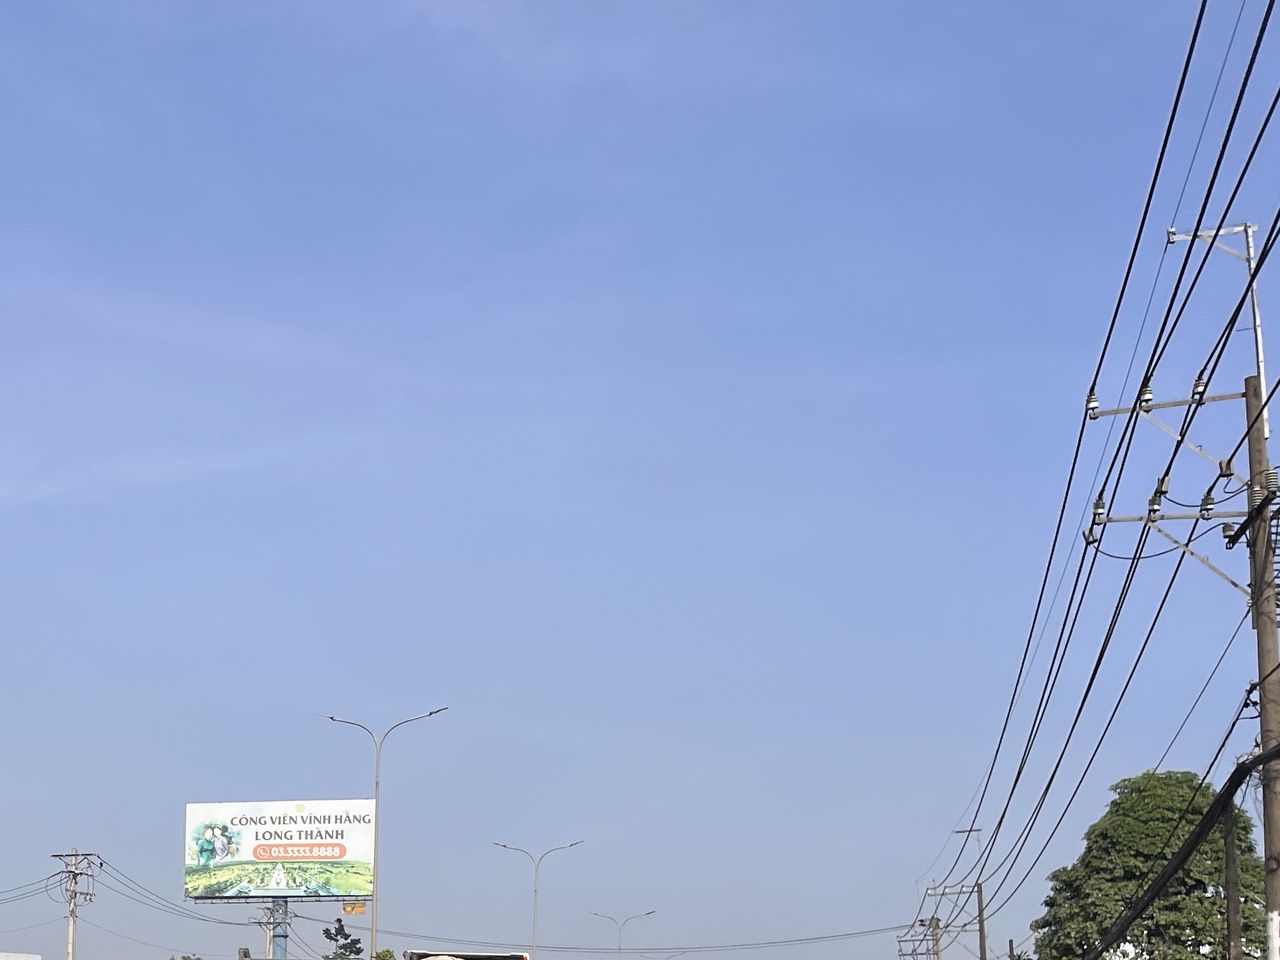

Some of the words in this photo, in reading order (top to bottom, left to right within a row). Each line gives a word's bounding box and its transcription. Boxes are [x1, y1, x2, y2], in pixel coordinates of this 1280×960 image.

[230, 814, 267, 826] CÔNG
[270, 813, 298, 825] VIÊN
[300, 812, 331, 825] VĨNH
[334, 810, 371, 825] HẰNG
[255, 830, 293, 841] LONG
[297, 826, 344, 840] THÀNH
[271, 846, 340, 857] 03.3333.8888
